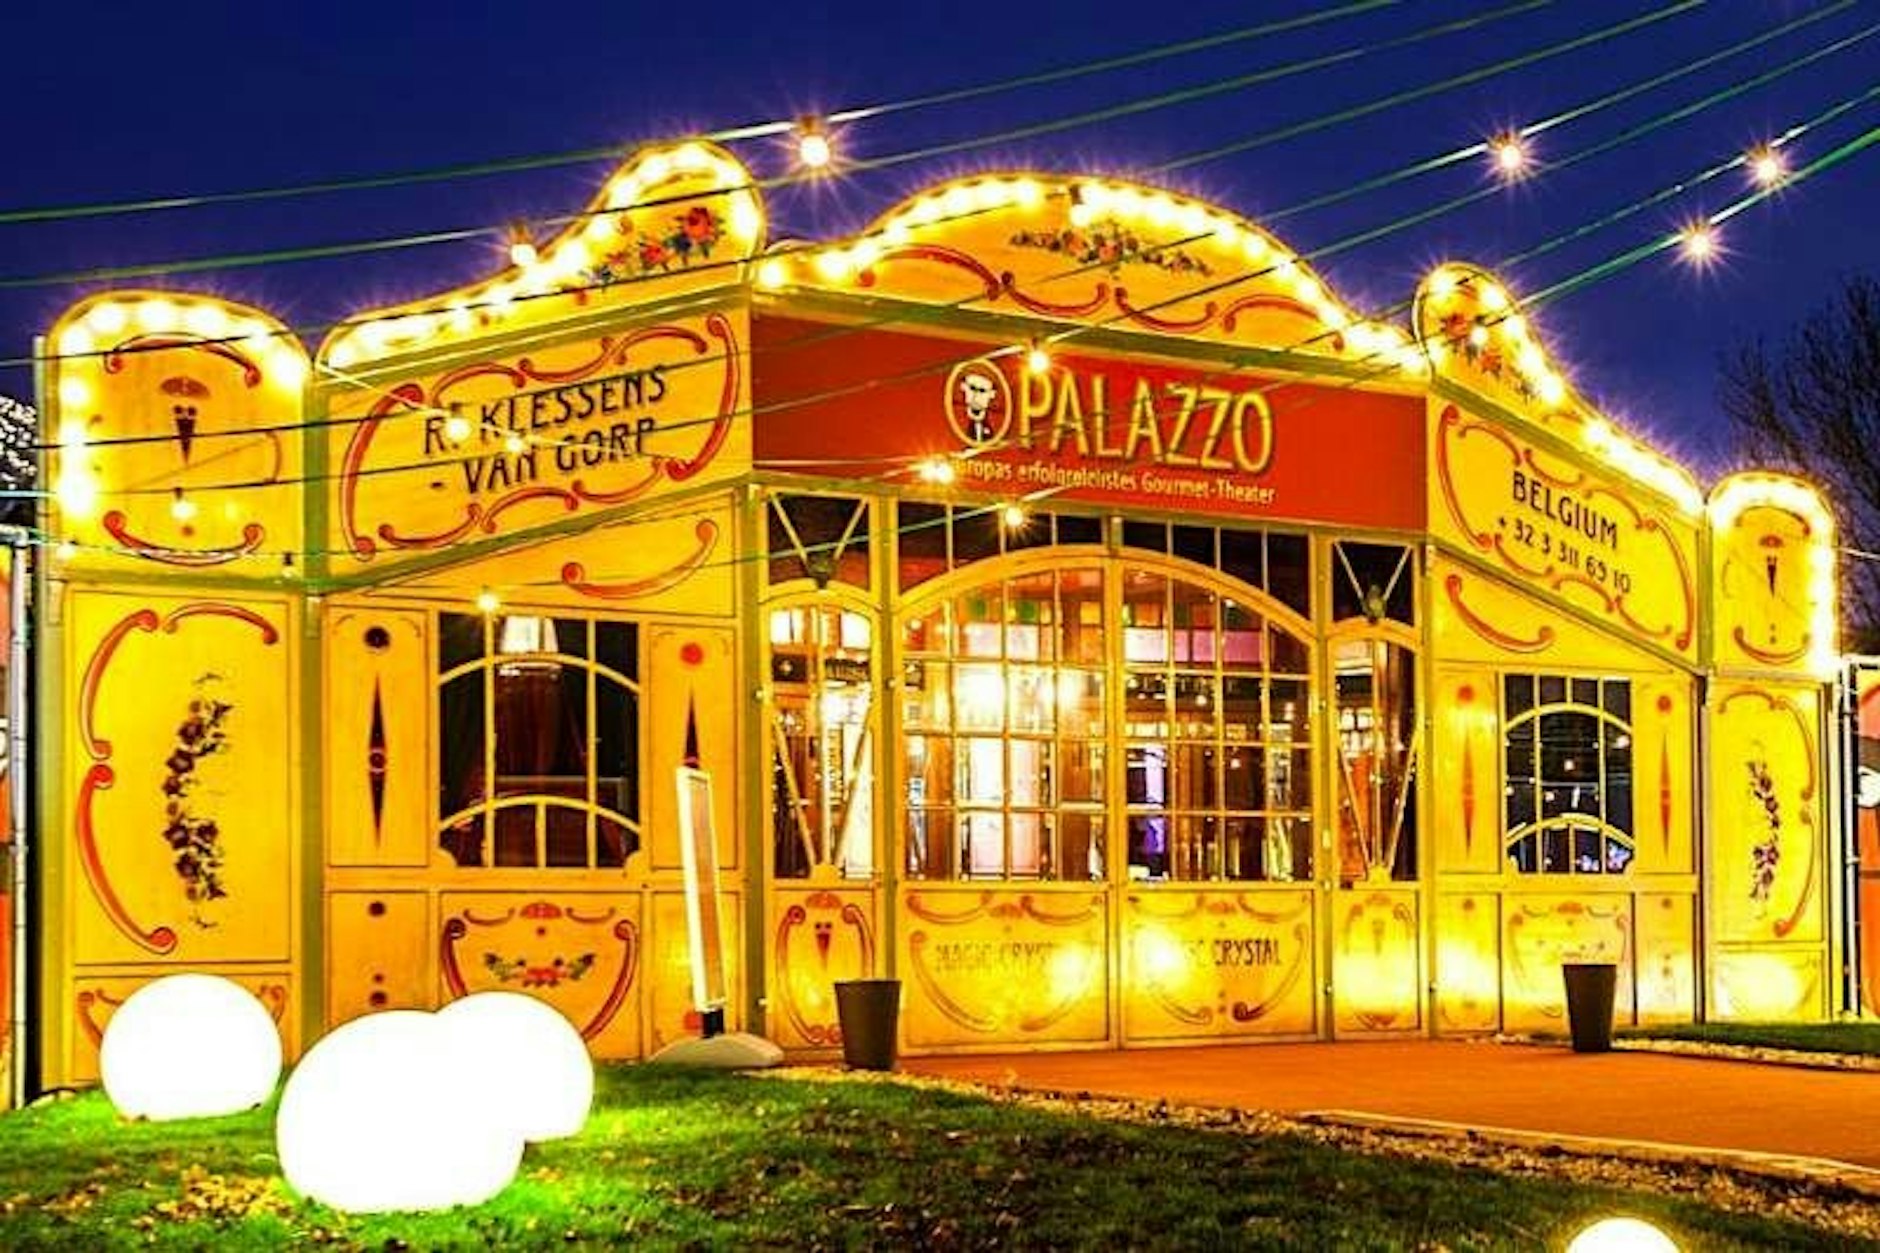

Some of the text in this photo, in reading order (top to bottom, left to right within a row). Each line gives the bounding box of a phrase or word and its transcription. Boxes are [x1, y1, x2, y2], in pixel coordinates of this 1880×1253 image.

[480, 366, 667, 444] KLESSENS
[1018, 364, 1275, 474] PALAZZO
[463, 442, 537, 494] VAN
[1140, 471, 1276, 505] Gourmet-Theater
[1512, 470, 1618, 550] BELGIUM
[1514, 517, 1534, 547] 32
[1213, 938, 1282, 967] CRYSTAL
